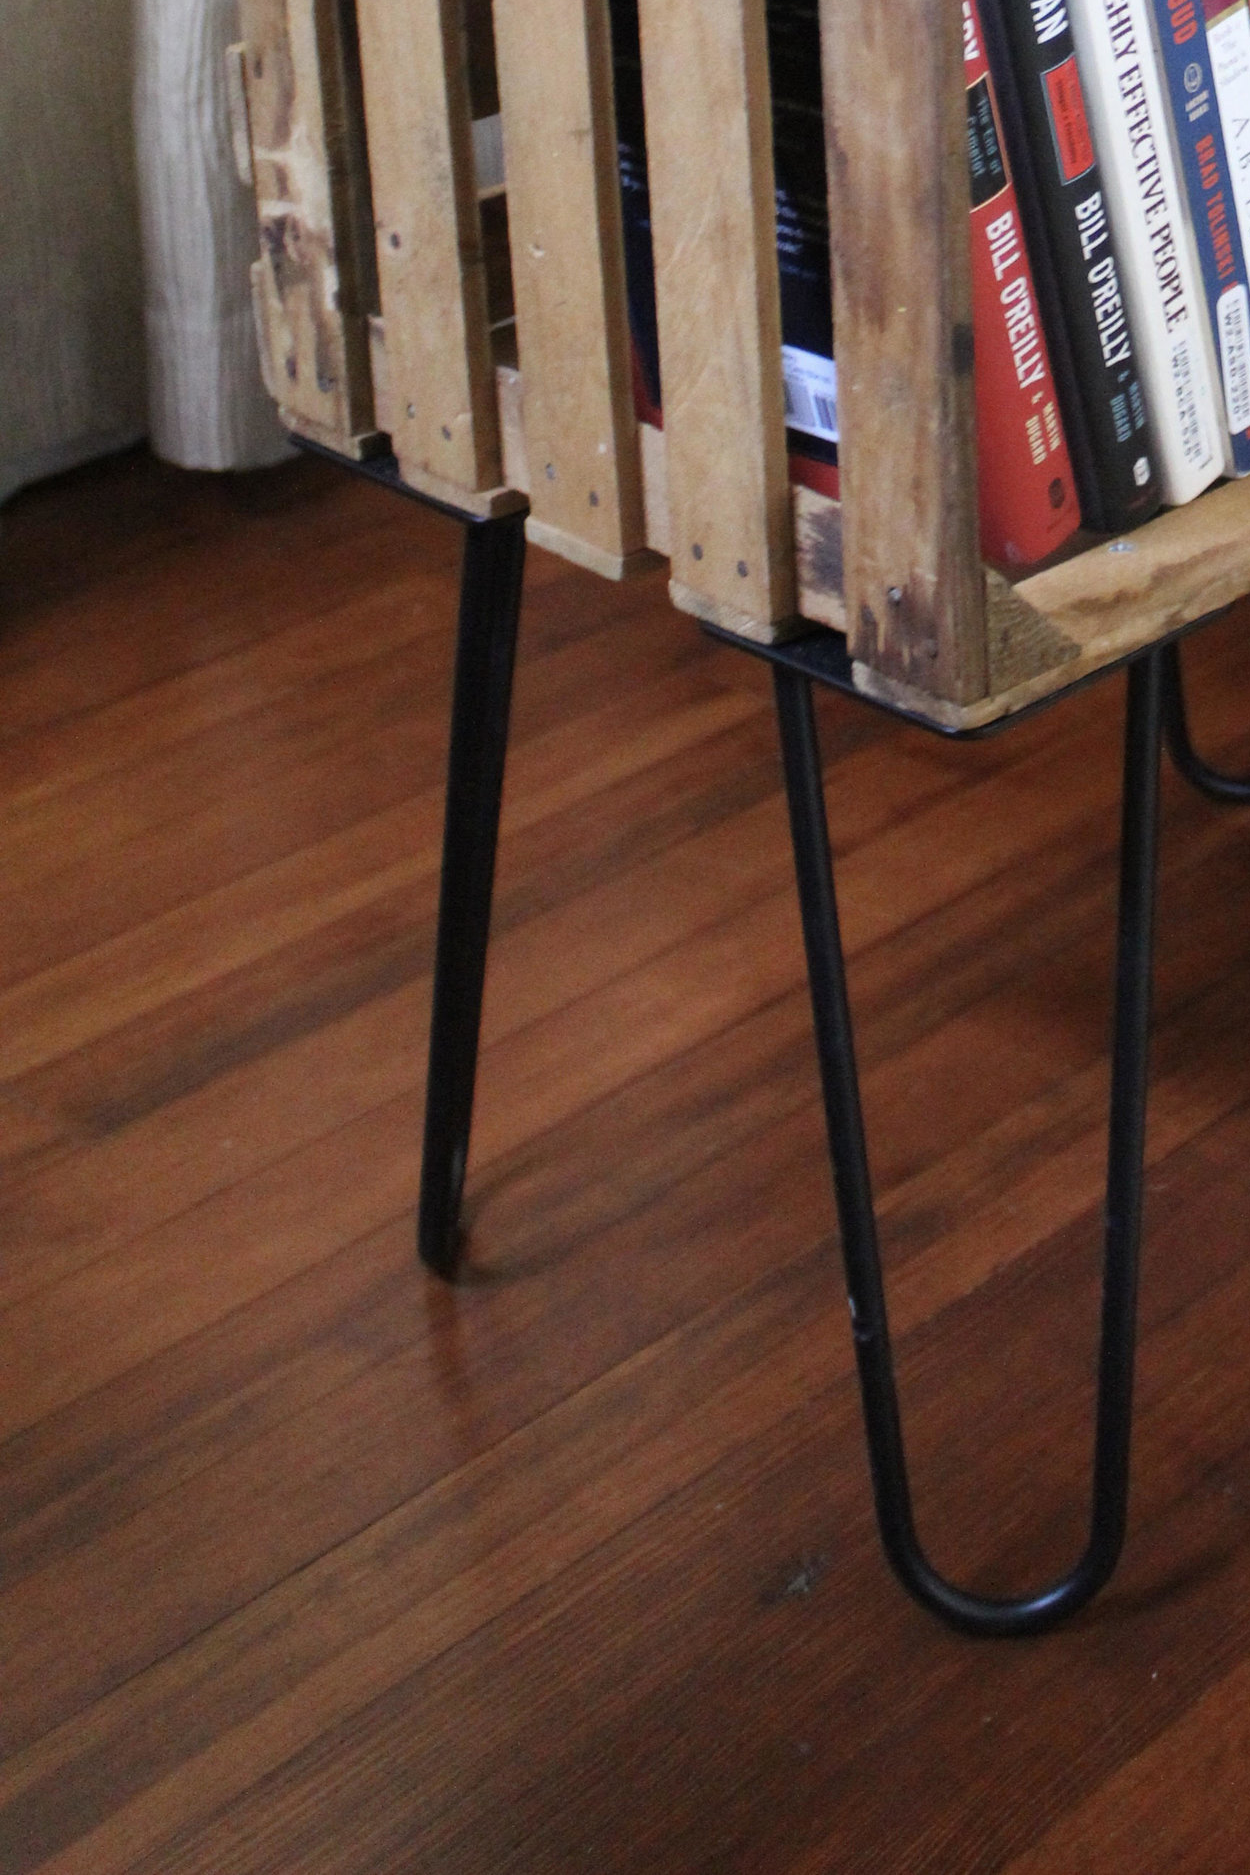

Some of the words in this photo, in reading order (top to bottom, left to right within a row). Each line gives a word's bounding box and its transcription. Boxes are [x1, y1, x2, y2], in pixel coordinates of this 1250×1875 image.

[1195, 134, 1220, 190] BRAD
[1074, 191, 1109, 261] BILL
[1118, 64, 1168, 225] EFFECTIVE
[1150, 223, 1188, 333] PEOPLE
[985, 210, 1021, 282] BILL
[1000, 275, 1046, 390] O'REILLY
[1087, 255, 1132, 368] O'REILLY
[1025, 413, 1048, 465] DUGARD
[1110, 392, 1133, 444] DUGARD
